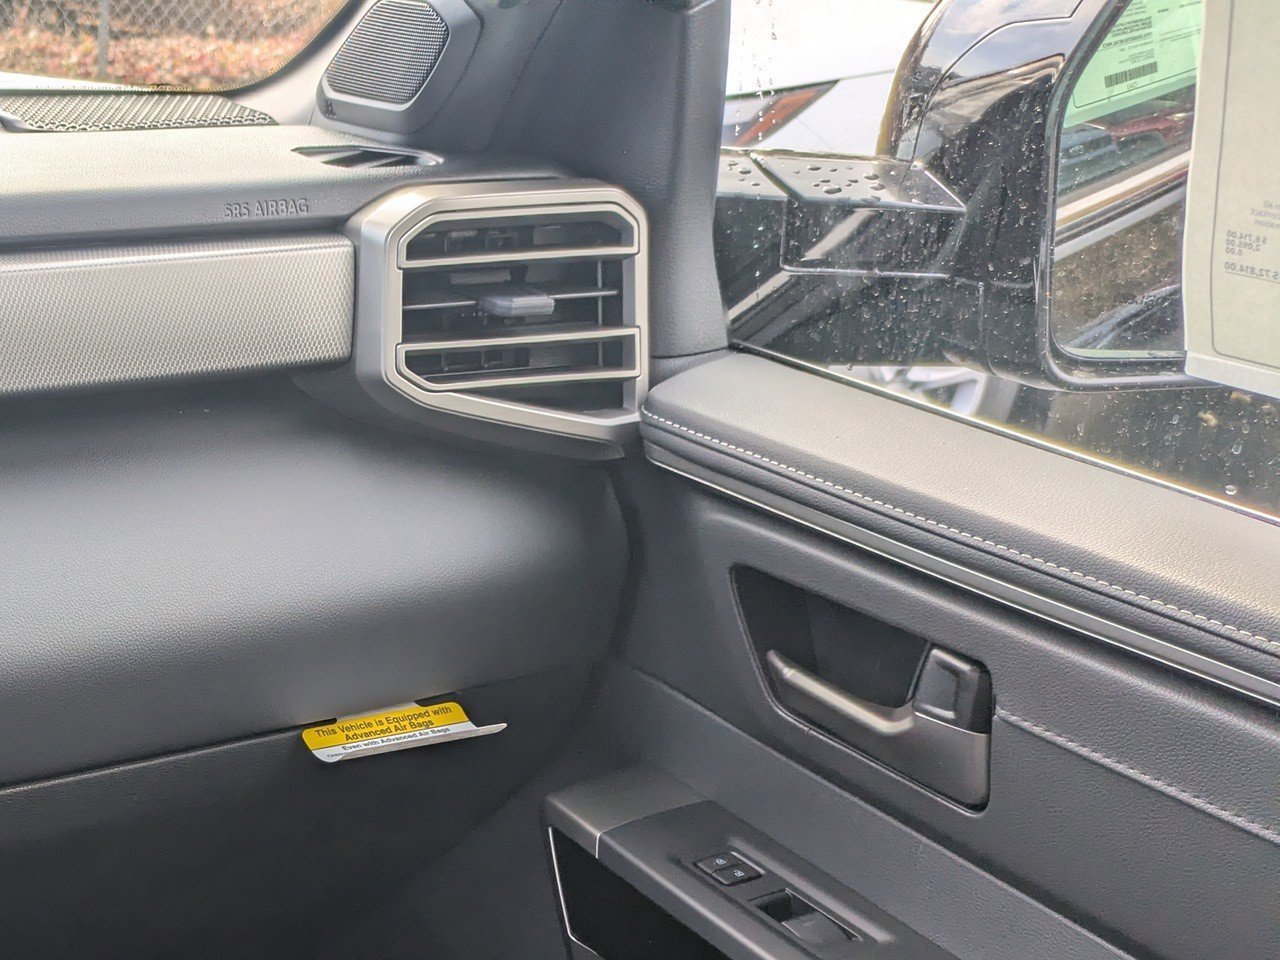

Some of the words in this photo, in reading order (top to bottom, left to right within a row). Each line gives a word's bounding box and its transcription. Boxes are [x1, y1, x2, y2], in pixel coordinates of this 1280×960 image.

[224, 202, 250, 218] SRS
[254, 198, 309, 217] AIRBAG
[314, 728, 337, 738] This
[338, 721, 373, 734] Vehicle
[374, 718, 384, 727] is
[385, 710, 431, 726] Equipped
[432, 706, 452, 717] with
[345, 728, 392, 742] Advanced
[394, 723, 409, 733] Air
[410, 719, 435, 731] Bags
[341, 743, 361, 751] Even
[361, 740, 379, 748] with
[380, 733, 418, 745] Advanced
[419, 730, 431, 738] Air
[432, 727, 451, 736] Bags
